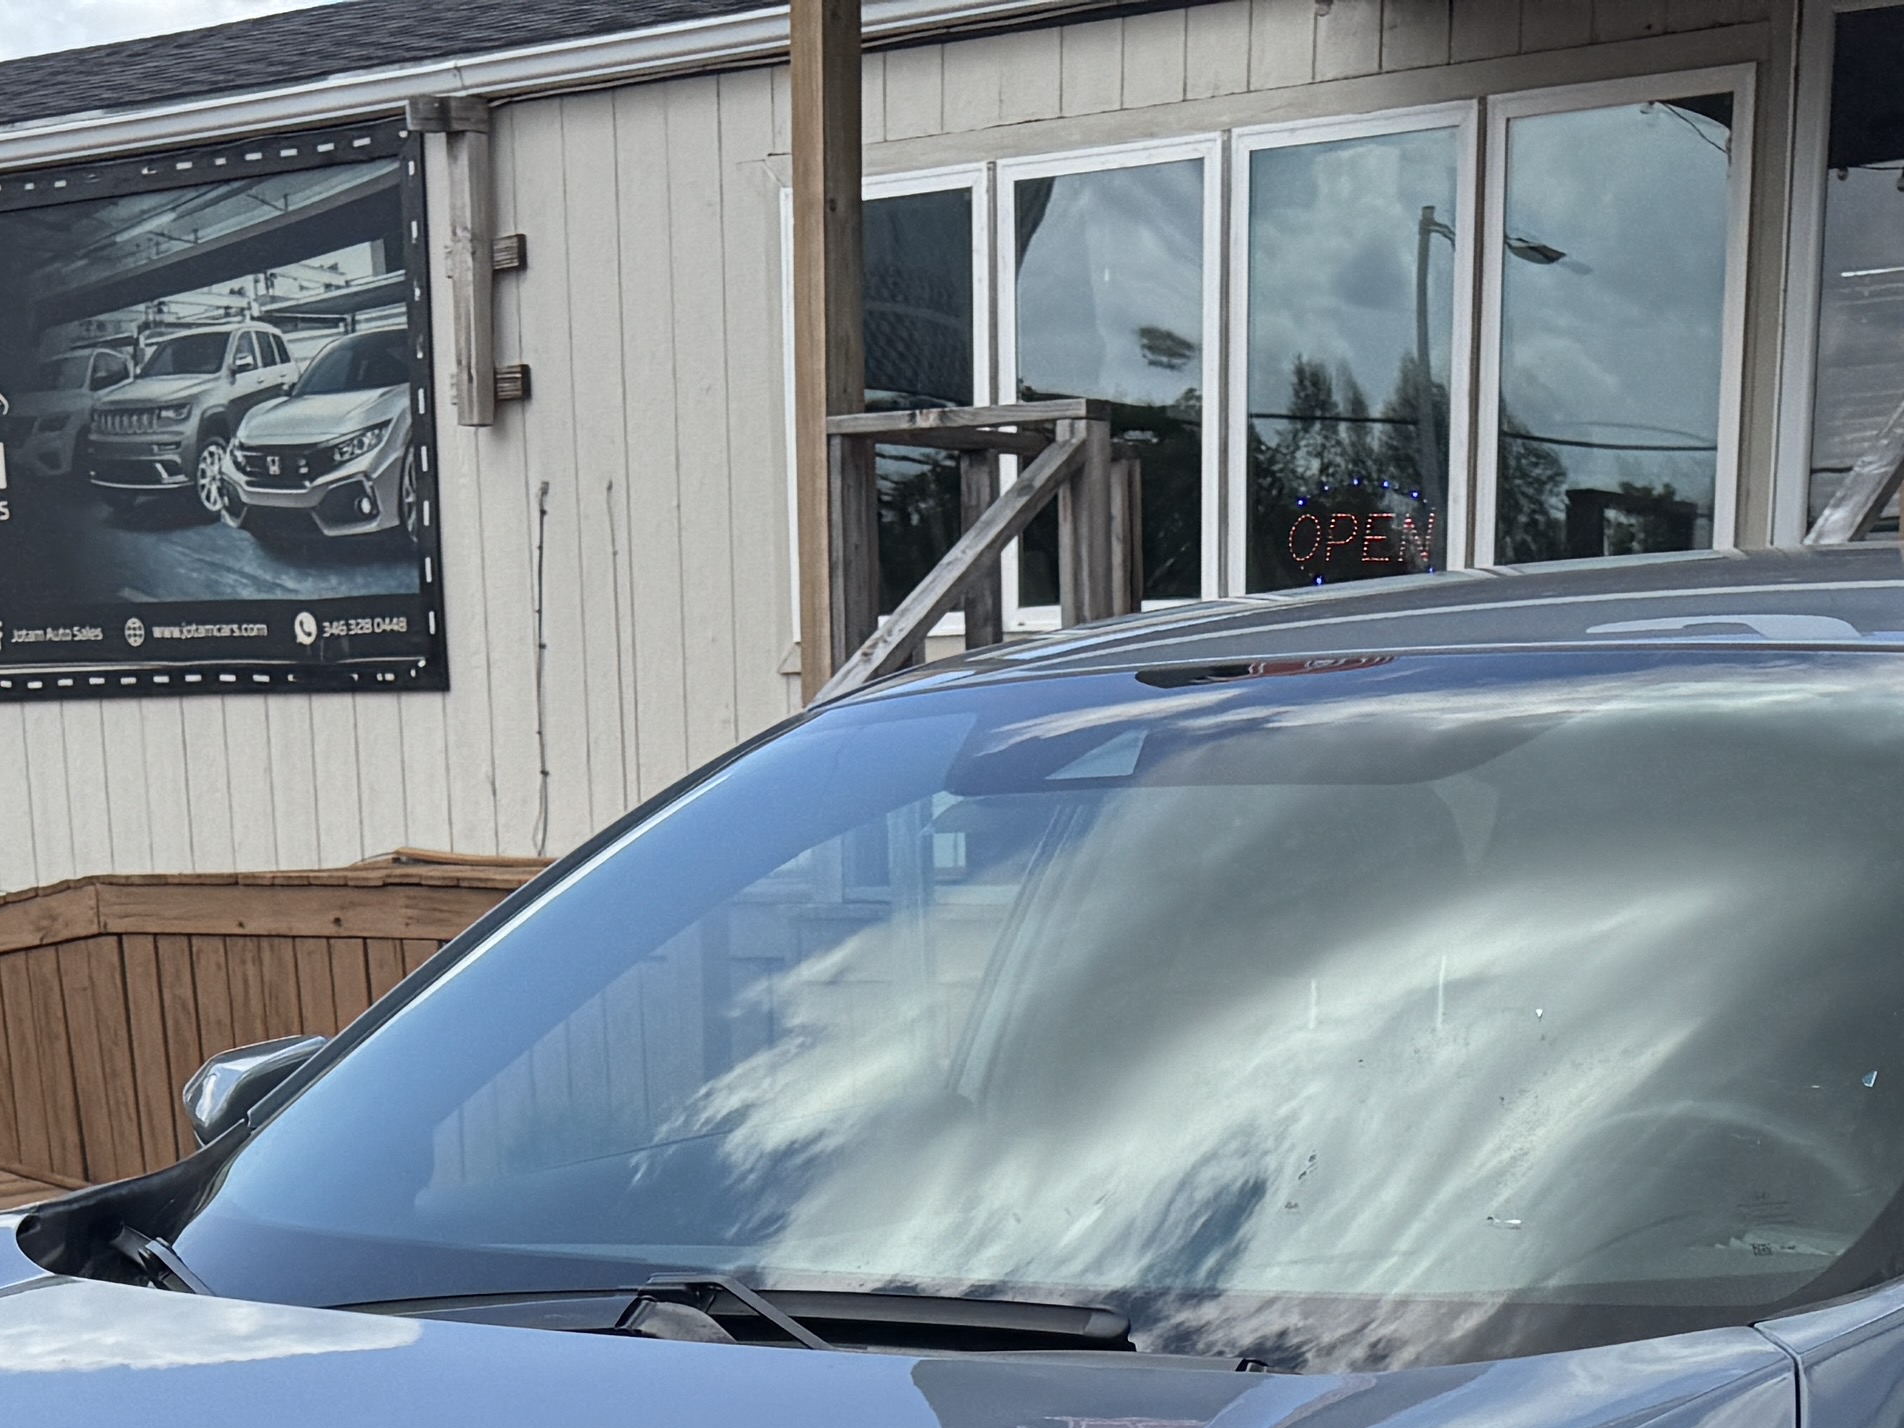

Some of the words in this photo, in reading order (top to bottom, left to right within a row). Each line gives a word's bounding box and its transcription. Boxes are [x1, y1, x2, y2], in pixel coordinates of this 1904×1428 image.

[1289, 506, 1436, 562] OPEN
[11, 628, 45, 643] Jotam
[46, 627, 72, 642] Auto
[73, 626, 103, 641] Sales
[152, 622, 268, 640] www.jotamcars.com
[322, 620, 347, 638] 346
[348, 618, 372, 637] 328
[374, 617, 407, 633] 0448
